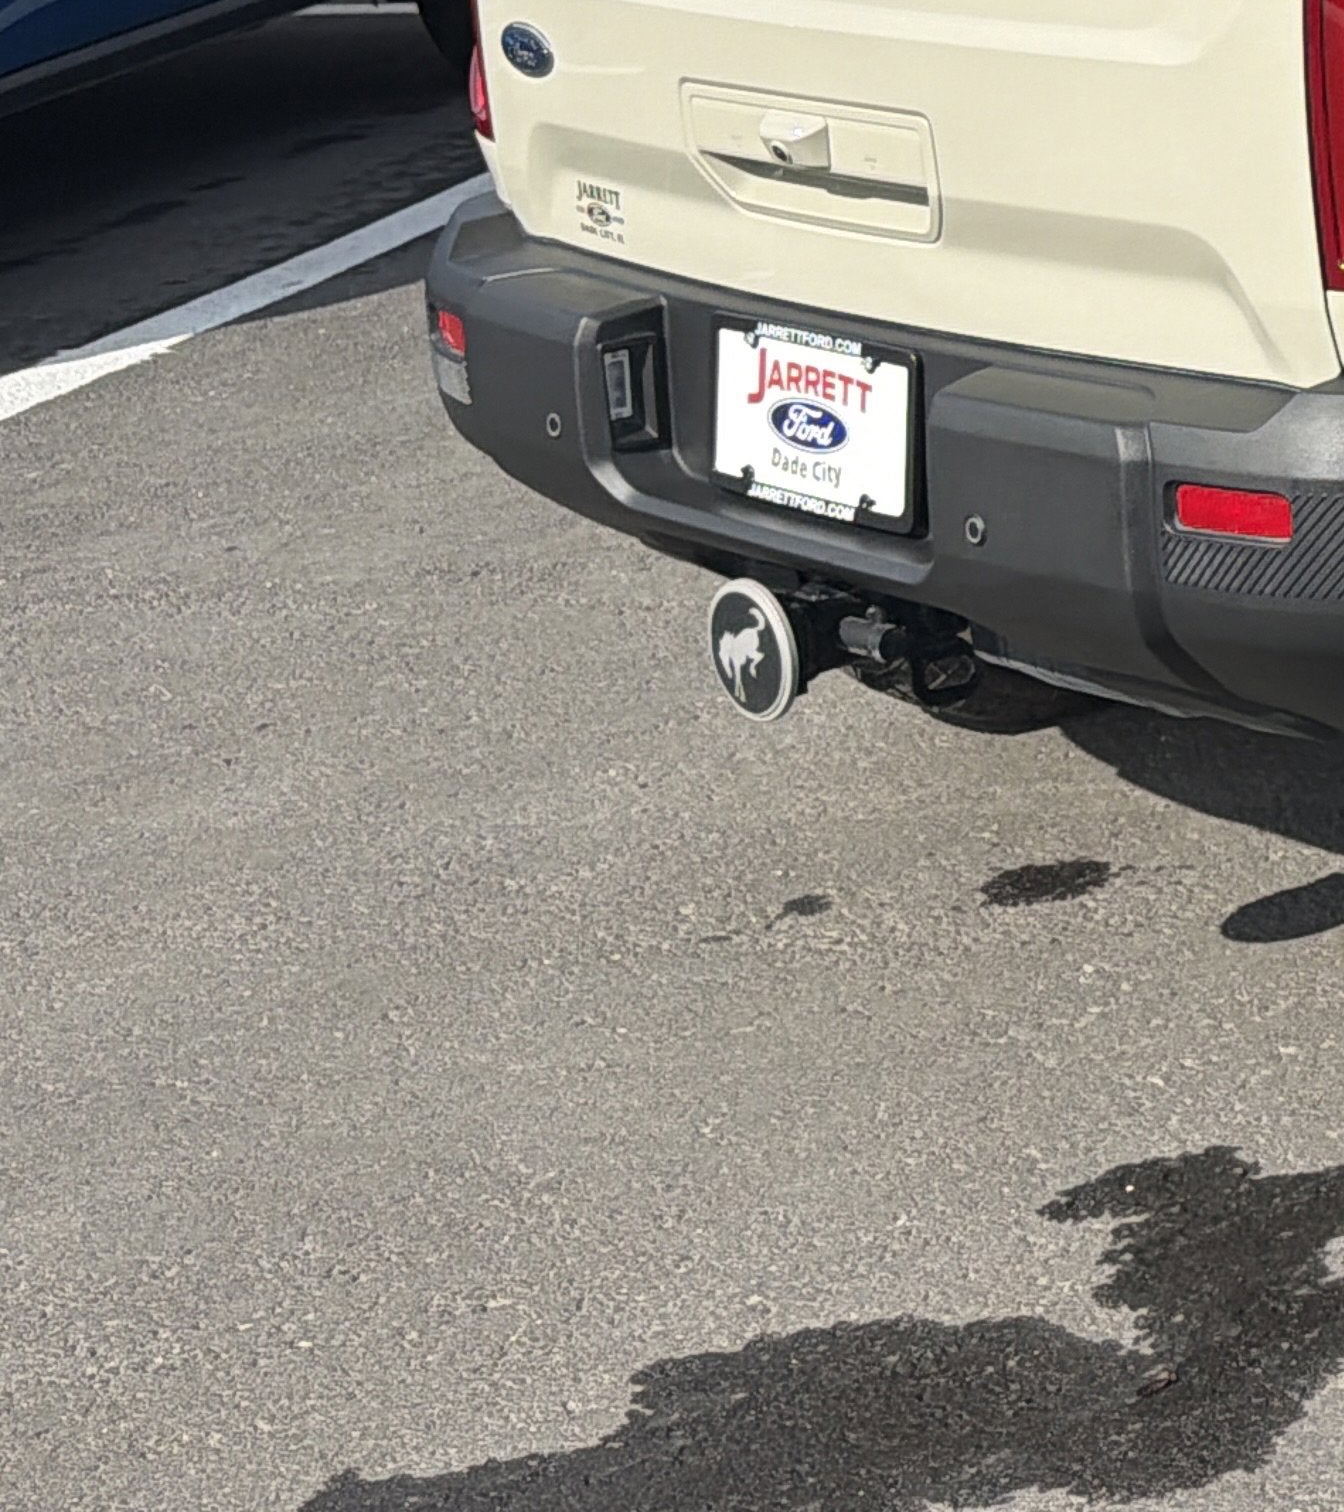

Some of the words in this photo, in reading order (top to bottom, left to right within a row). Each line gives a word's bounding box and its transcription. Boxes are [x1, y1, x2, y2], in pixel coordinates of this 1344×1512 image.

[754, 321, 862, 355] JARRETTFORD.COM
[747, 347, 873, 413] JARRETT
[782, 403, 835, 447] Ford
[771, 447, 808, 479] Dade
[812, 460, 842, 489] City
[747, 483, 855, 522] JARRETTFORD.COM
